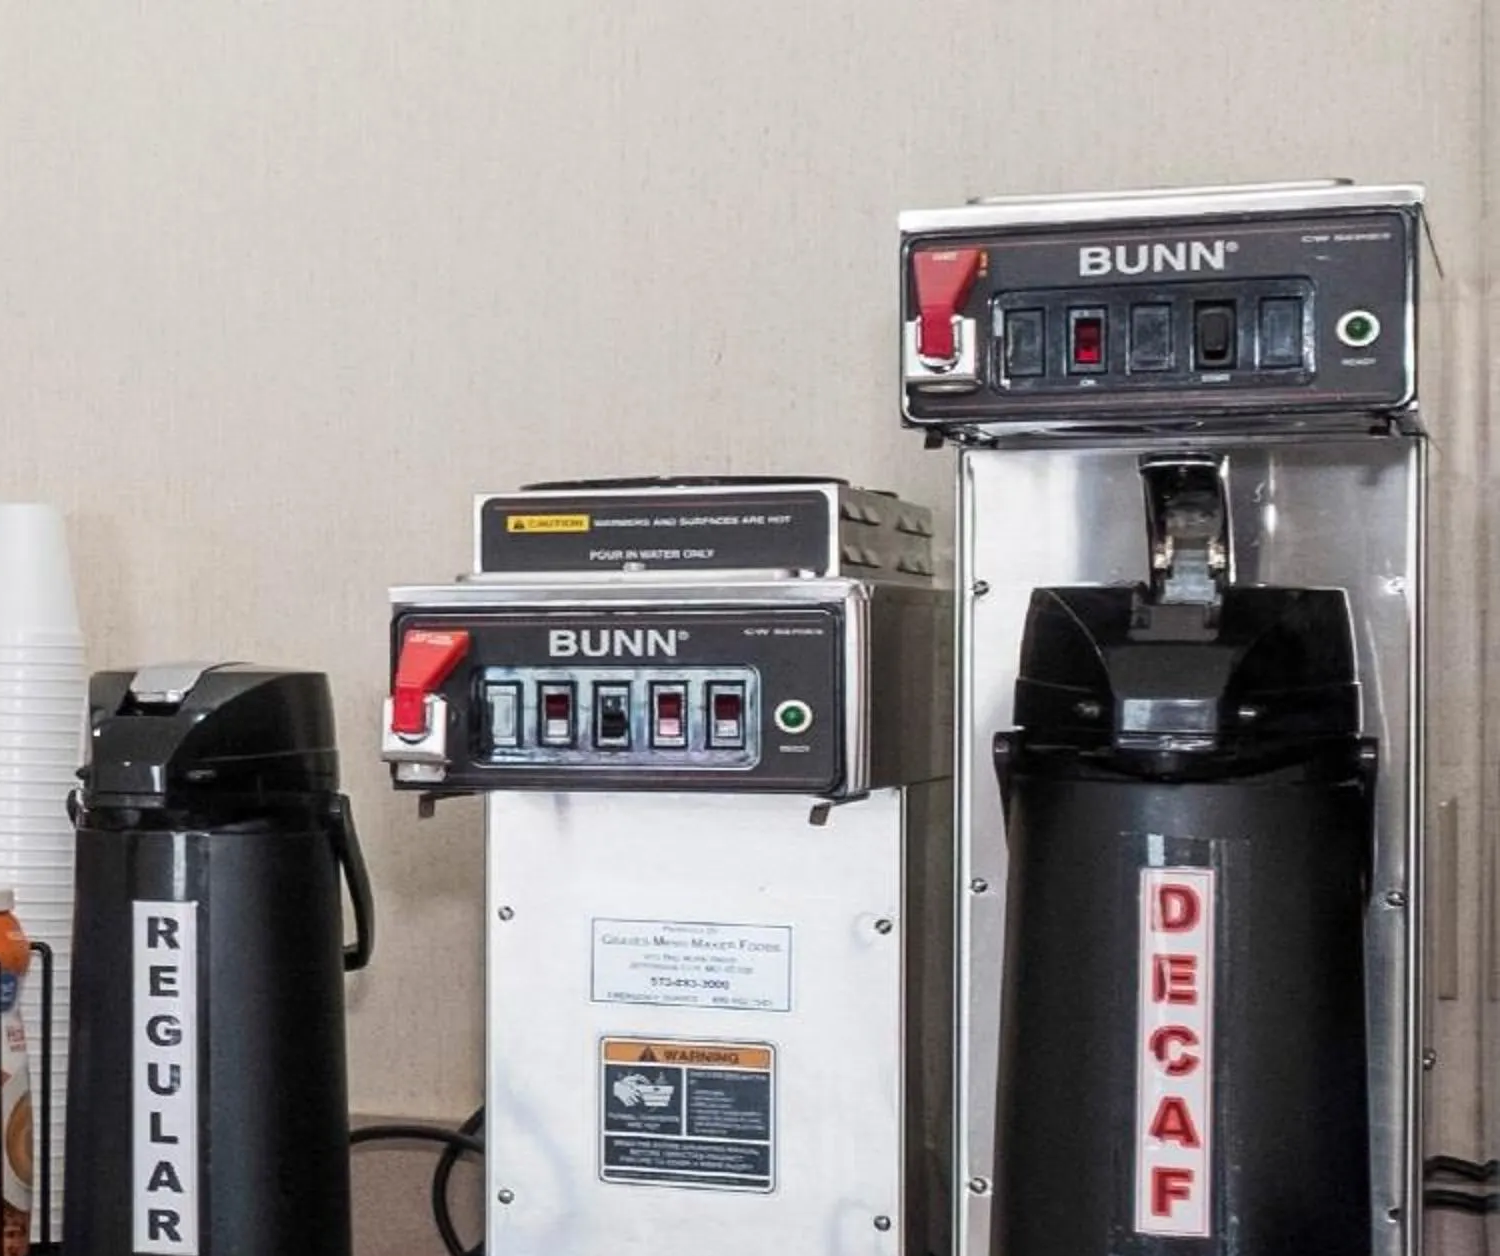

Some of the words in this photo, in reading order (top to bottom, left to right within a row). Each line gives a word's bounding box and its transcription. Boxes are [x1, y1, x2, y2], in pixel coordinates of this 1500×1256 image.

[146, 916, 183, 1242] REGULAR
[663, 1049, 739, 1064] WARNING
[1150, 883, 1201, 1217] DECAF
